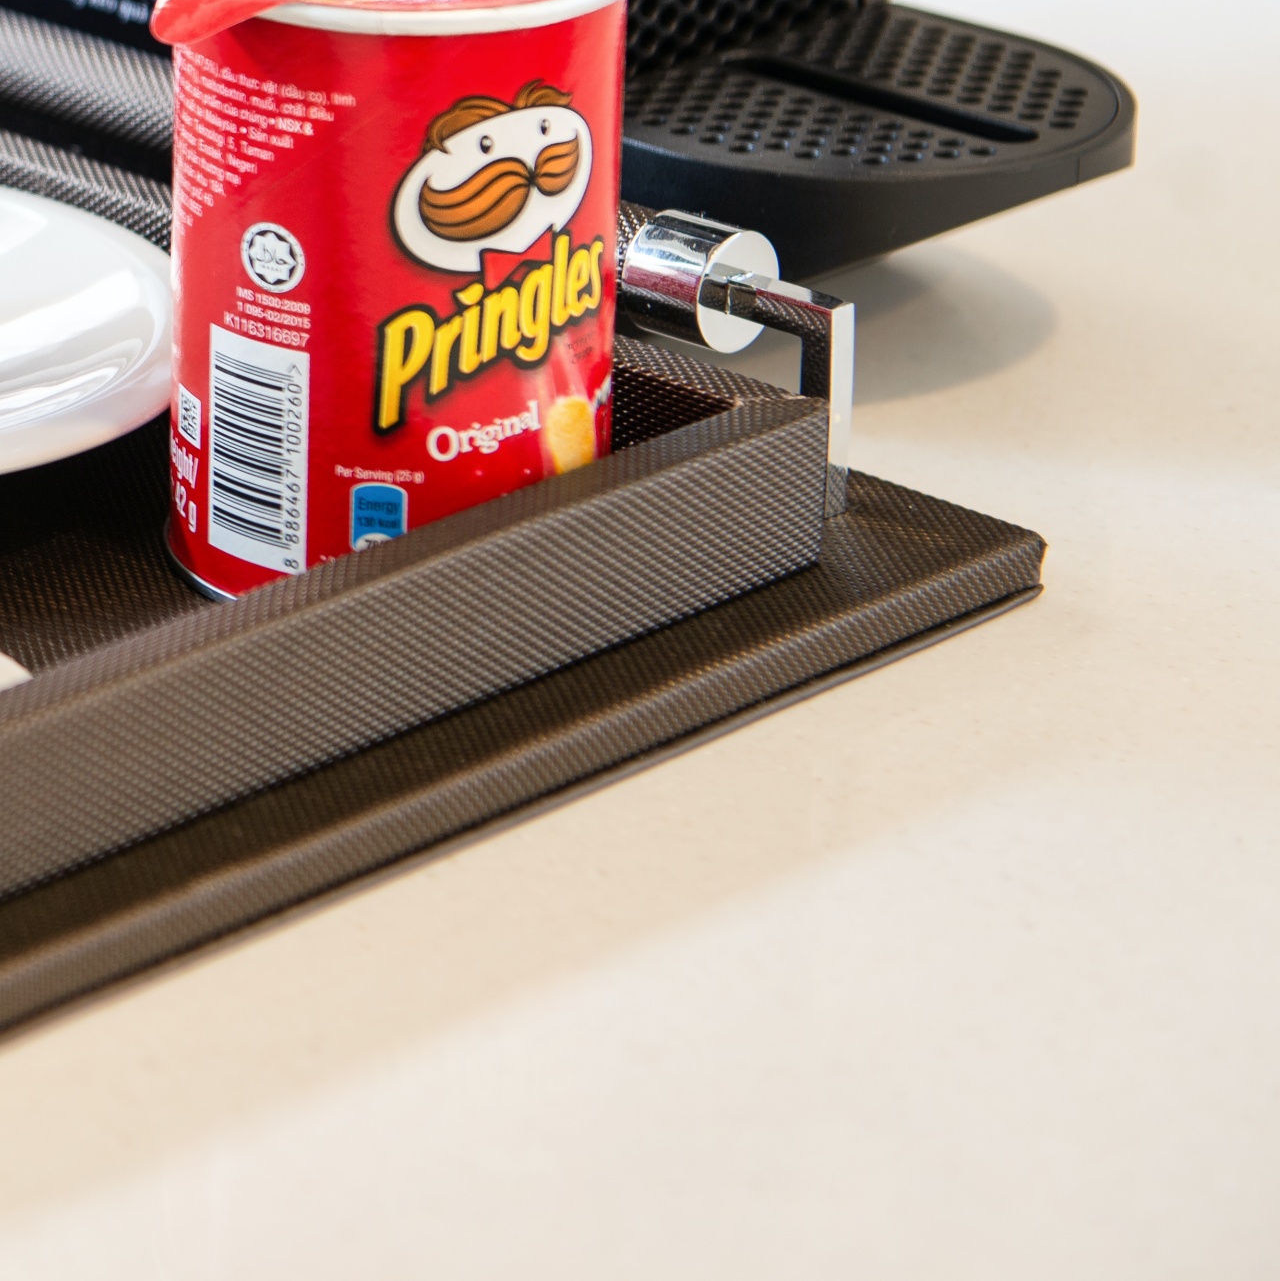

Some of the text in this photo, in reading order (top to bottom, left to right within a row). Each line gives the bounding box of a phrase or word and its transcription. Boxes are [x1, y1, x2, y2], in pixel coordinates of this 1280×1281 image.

[376, 233, 604, 432] Pringles
[171, 428, 199, 488] eight/
[426, 400, 541, 462] Original
[335, 464, 354, 479] Per
[355, 466, 393, 484] Serving
[358, 497, 401, 515] Energy
